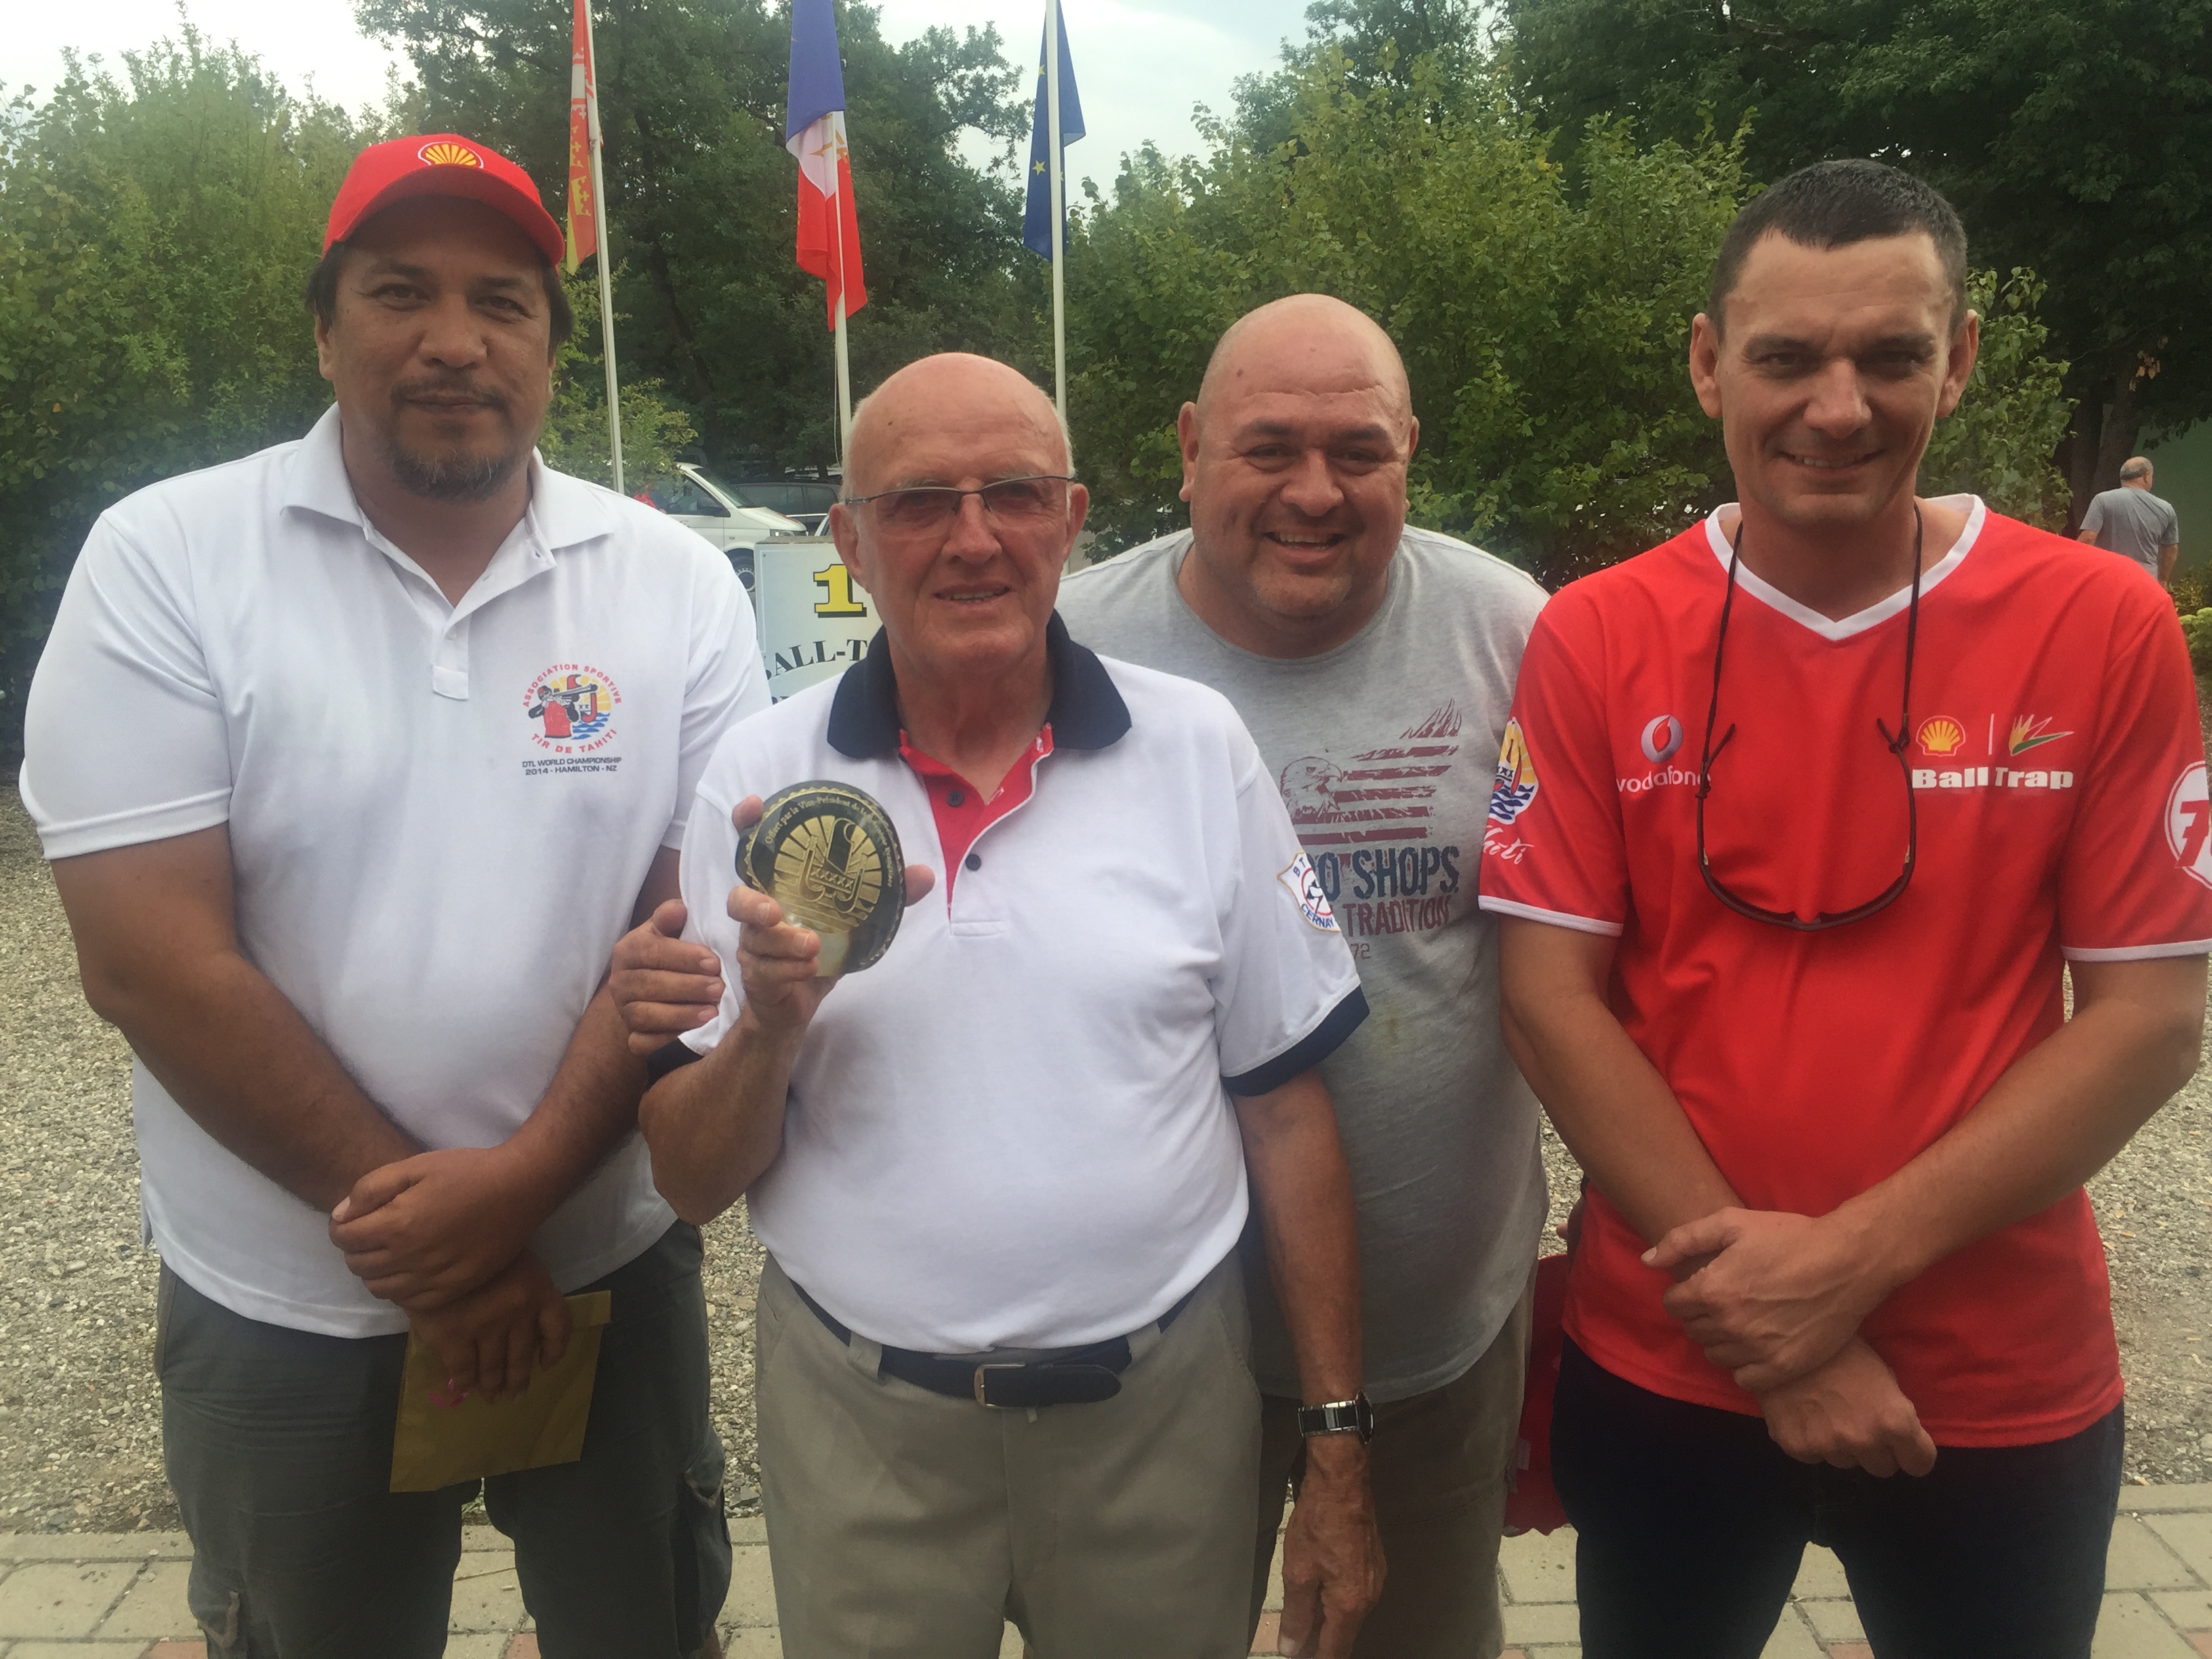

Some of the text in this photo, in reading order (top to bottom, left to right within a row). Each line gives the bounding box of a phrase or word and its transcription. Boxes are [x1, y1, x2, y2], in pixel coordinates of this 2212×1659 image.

[766, 639, 867, 680] ALL-T
[523, 664, 621, 707] ASSOCIATION SPORTIVE
[532, 729, 617, 754] TIR DE TAHITI
[526, 767, 548, 775] 2014
[1912, 766, 2074, 790] Ball Trap
[1300, 903, 1334, 928] CERNAY
[1343, 895, 1451, 937] TRADITION
